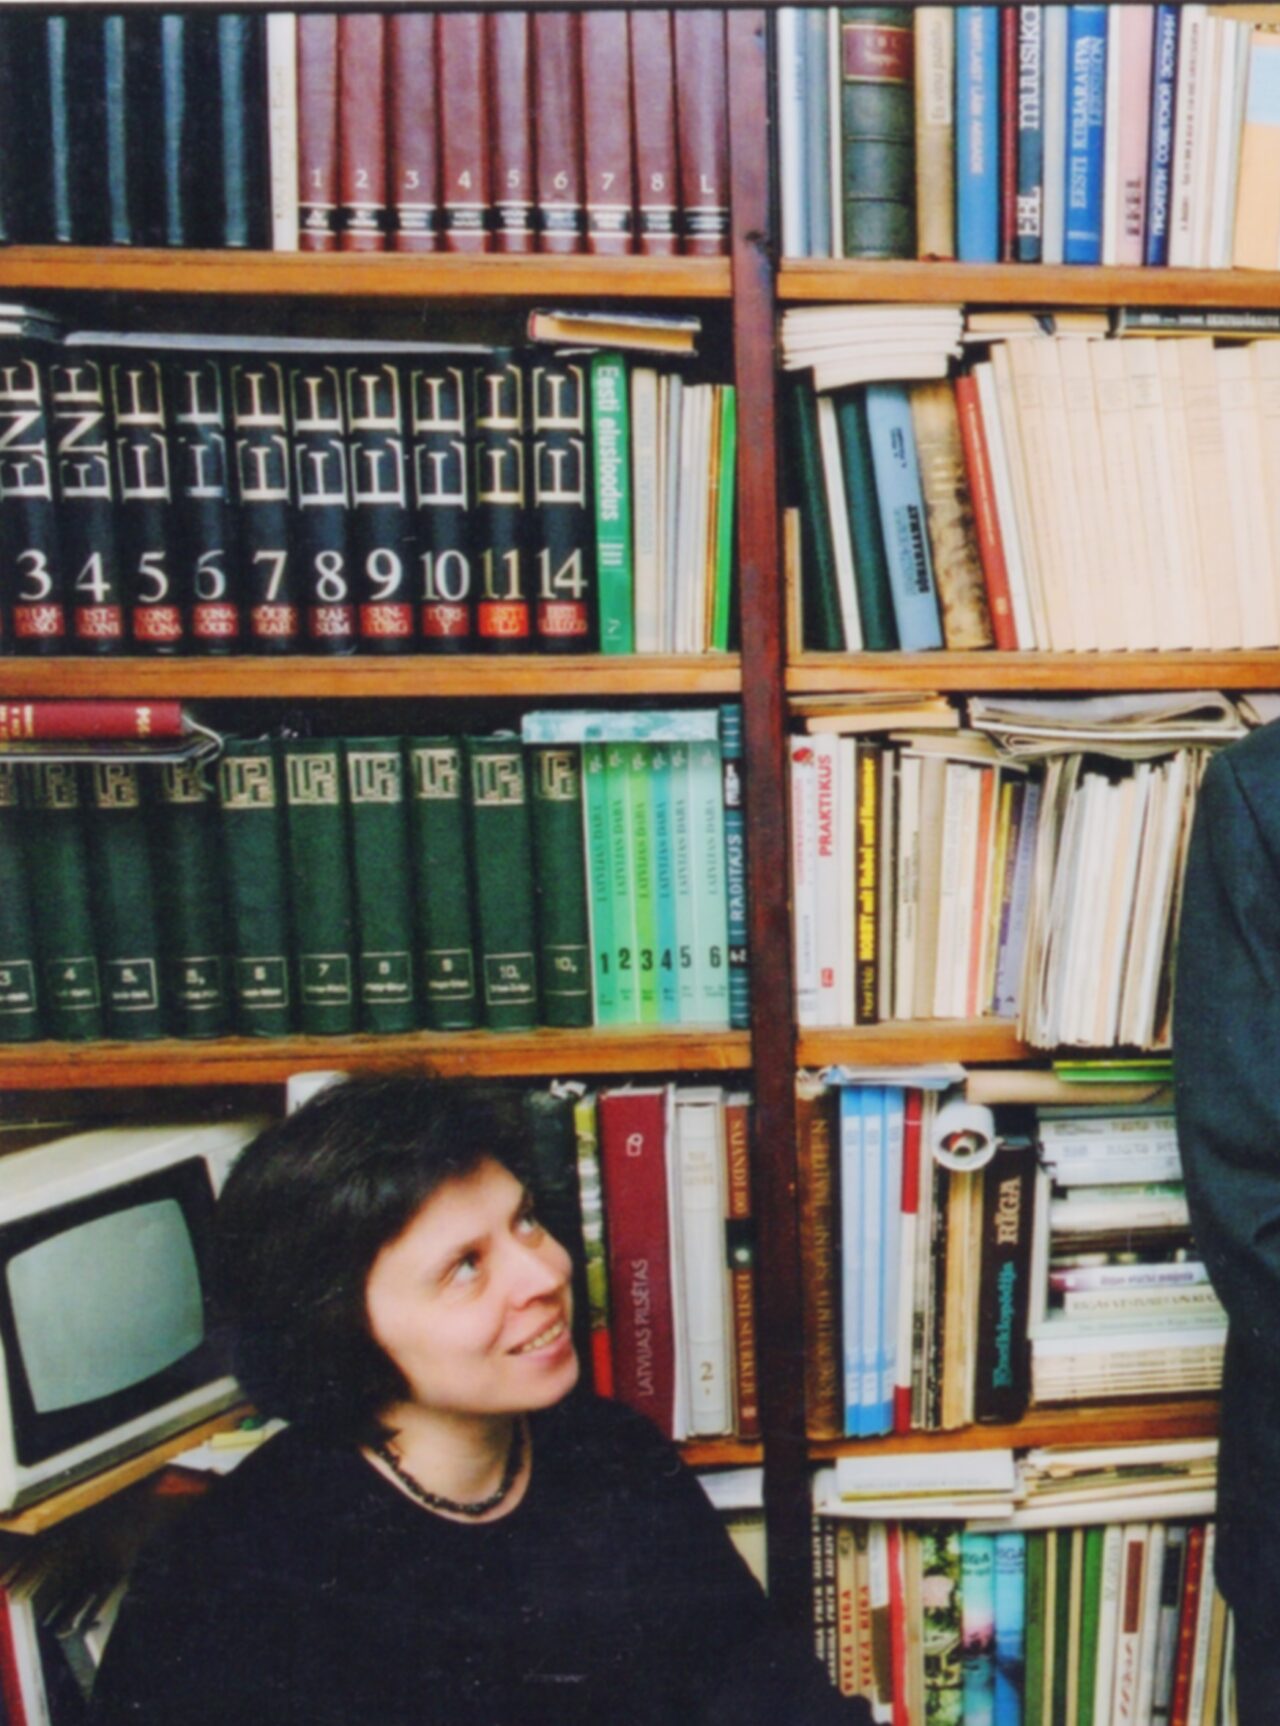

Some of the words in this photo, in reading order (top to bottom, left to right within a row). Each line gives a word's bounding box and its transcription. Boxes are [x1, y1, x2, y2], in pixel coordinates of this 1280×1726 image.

[312, 170, 322, 187] 1
[356, 170, 368, 188] 2
[406, 171, 419, 188] 3
[458, 171, 471, 188] 4
[508, 170, 520, 188] 5
[554, 171, 568, 189] 6
[602, 173, 613, 190] 7
[652, 174, 663, 190] 8
[1071, 157, 1087, 208] EESTI
[596, 366, 620, 413] Eesti
[17, 549, 51, 600] 3
[76, 551, 111, 602] 4
[138, 552, 168, 602] 5
[194, 550, 226, 600] 6
[253, 551, 287, 601] 7
[315, 551, 347, 601] 8
[366, 548, 402, 600] 9
[421, 550, 470, 601] 10
[483, 549, 524, 600] 11
[537, 548, 588, 599] 14
[816, 754, 834, 856] PRAKTIKUS
[601, 953, 609, 974] 1
[619, 948, 631, 970] 2
[641, 949, 653, 970] 3
[661, 949, 672, 970] 4
[680, 946, 691, 968] 5
[709, 946, 721, 968] 6
[994, 1177, 1021, 1244] RĪGA
[630, 1259, 651, 1324] PILSĒTAS
[636, 1328, 655, 1396] LATVIJAS
